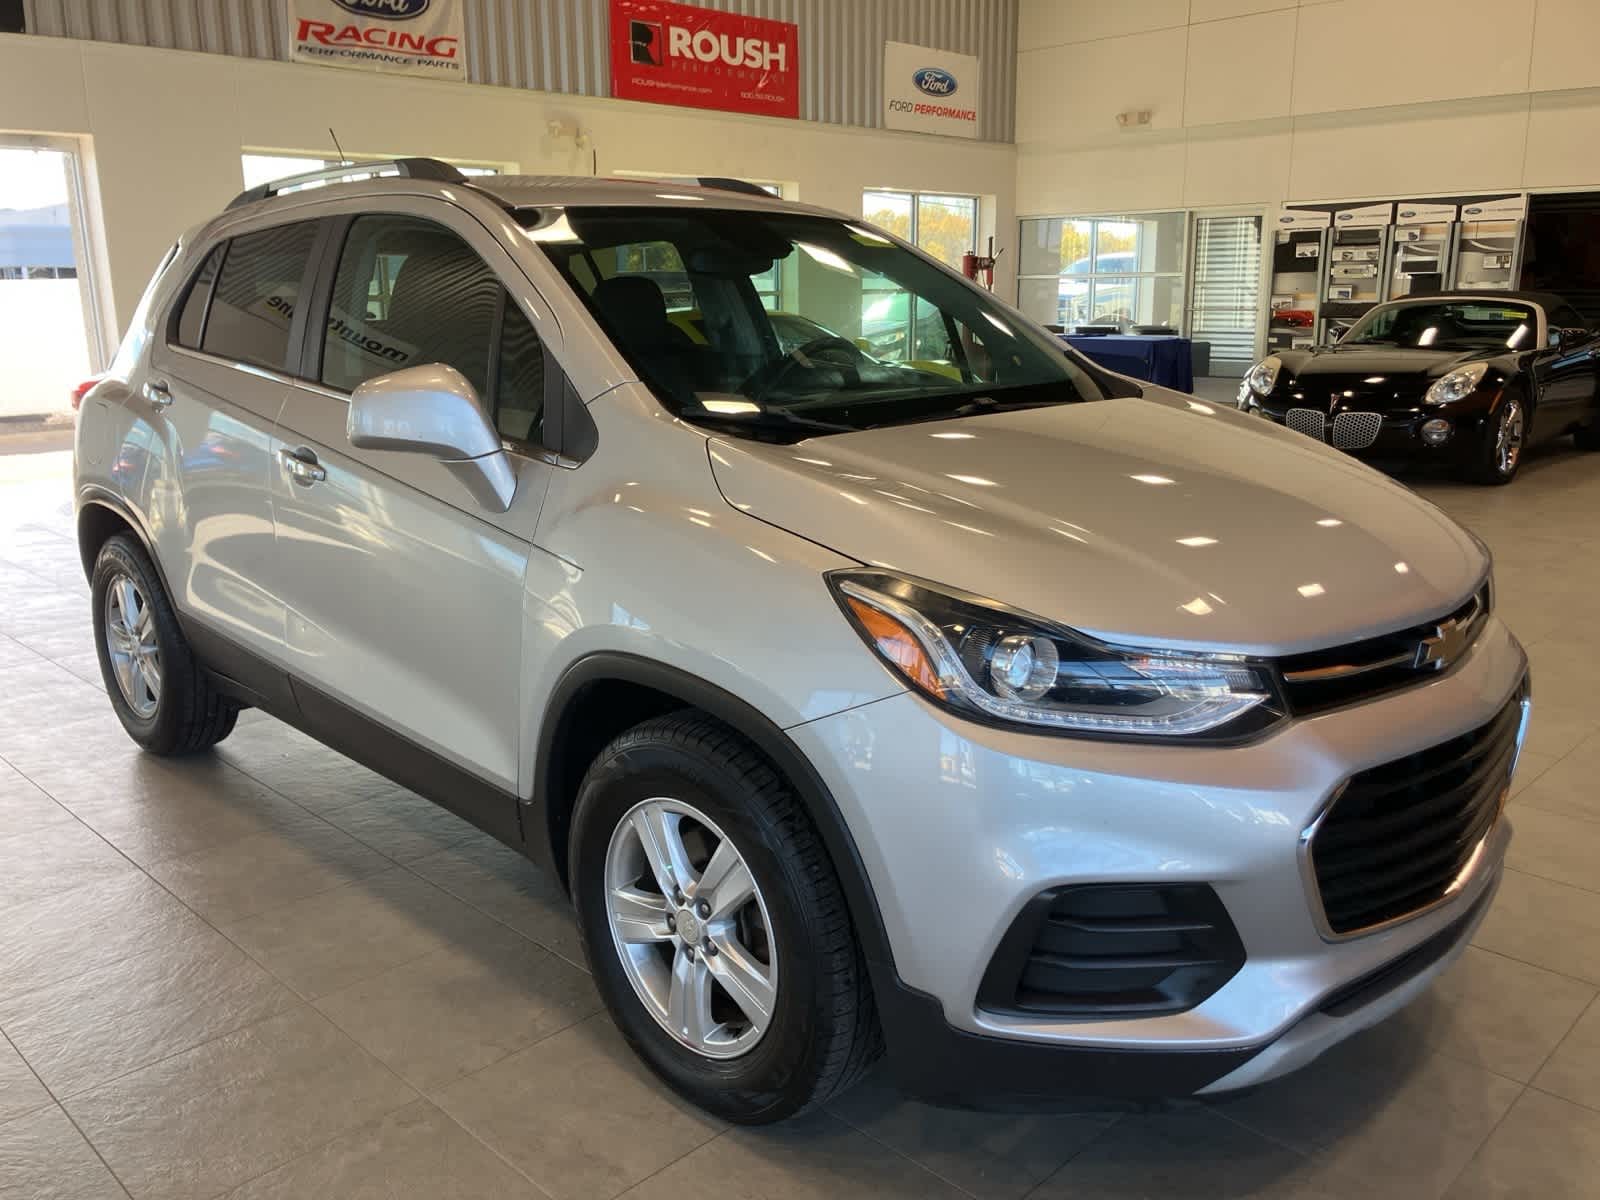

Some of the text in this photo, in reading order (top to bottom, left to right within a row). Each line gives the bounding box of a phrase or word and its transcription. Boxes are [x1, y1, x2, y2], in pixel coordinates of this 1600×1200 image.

[297, 18, 458, 58] RACING
[669, 26, 786, 72] ROUSH
[297, 45, 460, 70] PERFORMANCE PARTS
[922, 71, 949, 92] Ford
[889, 100, 976, 121] FORD PERFORMANCE
